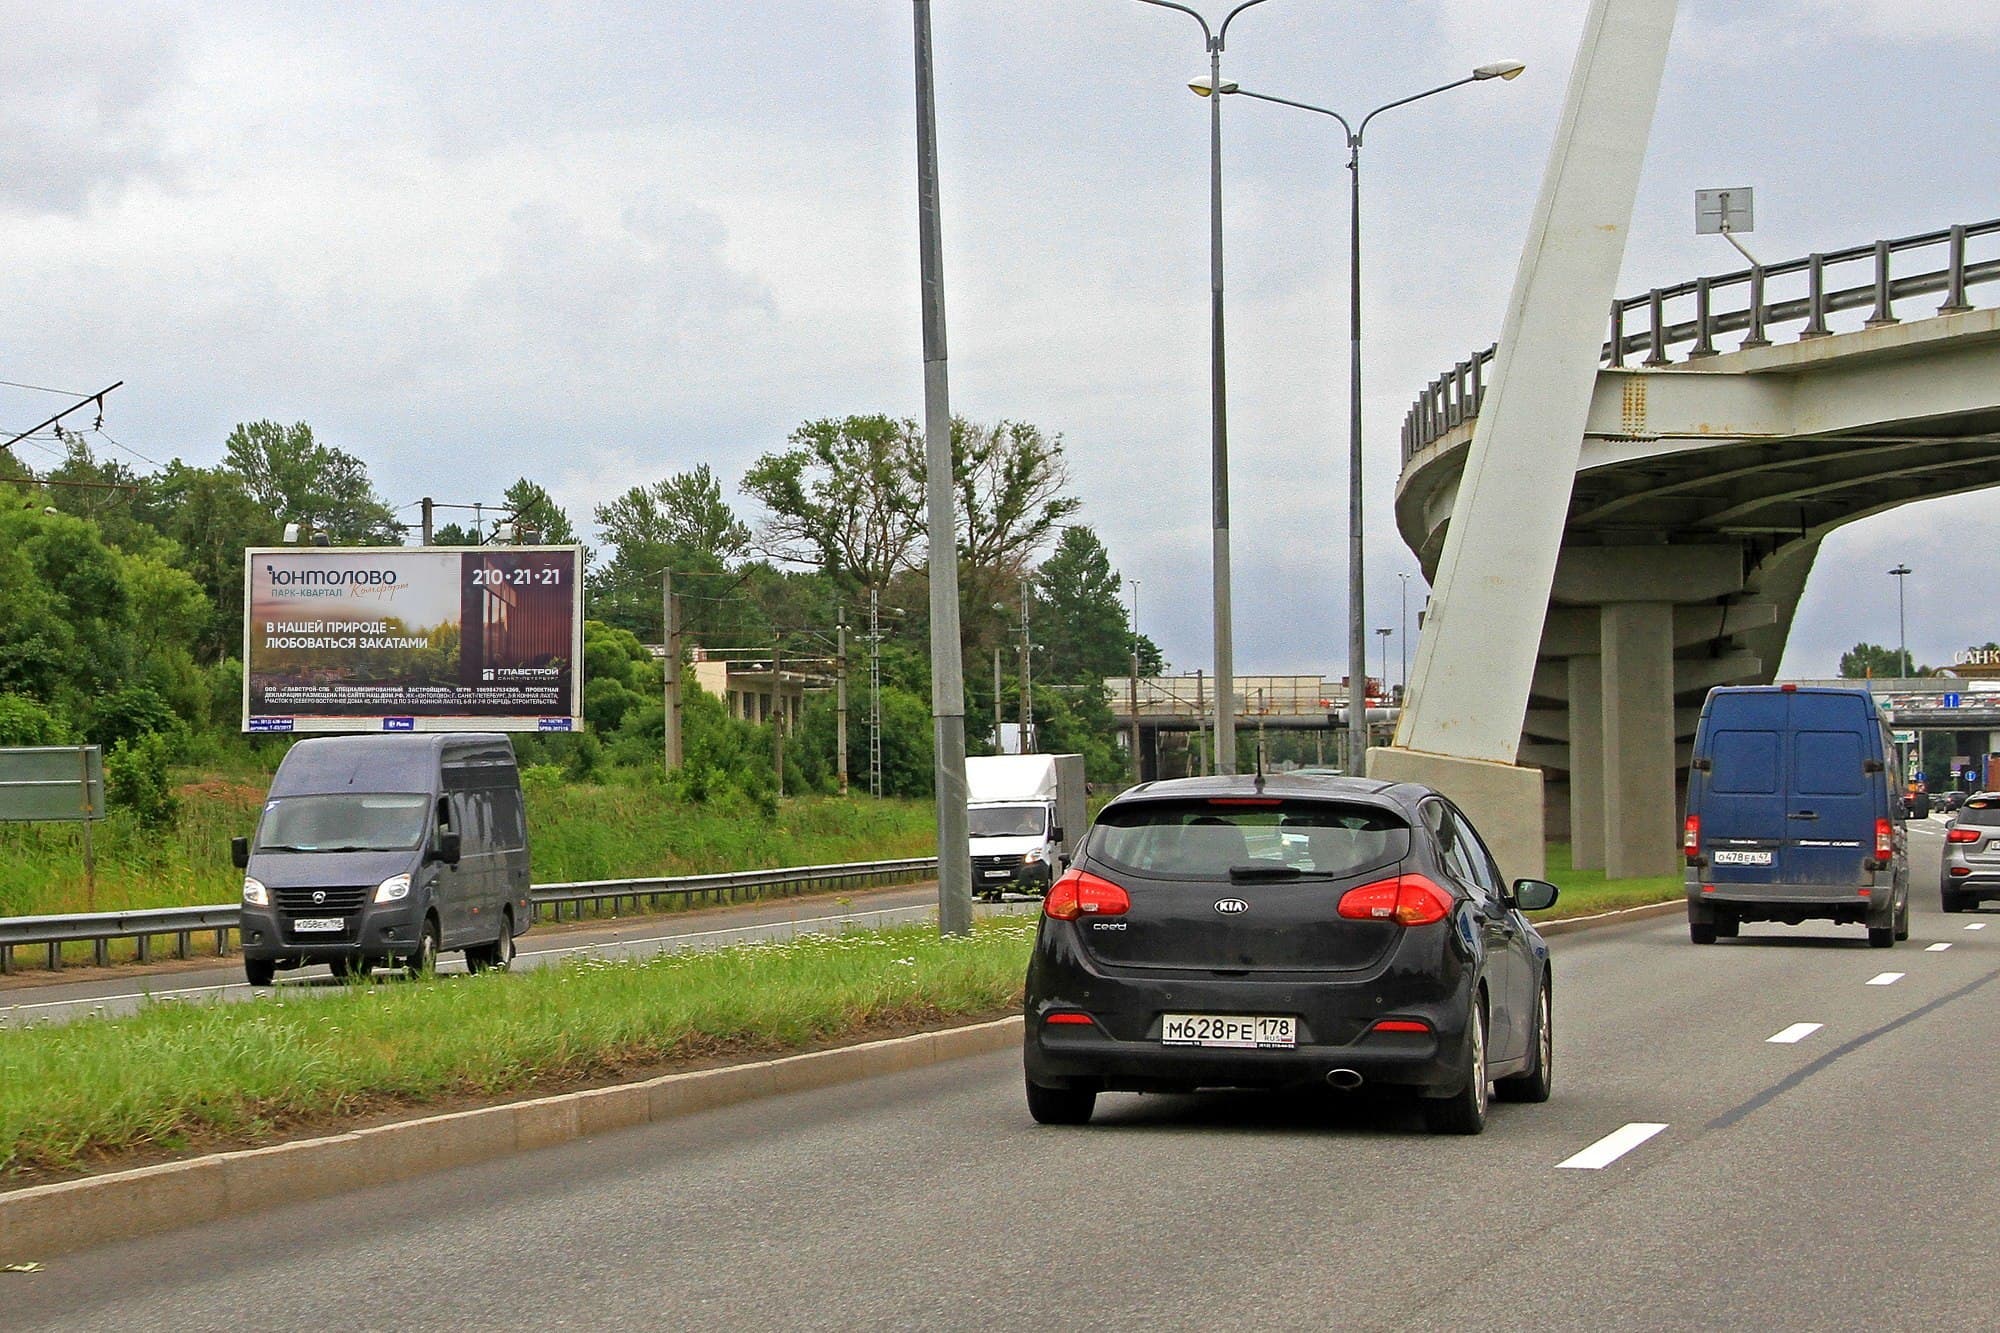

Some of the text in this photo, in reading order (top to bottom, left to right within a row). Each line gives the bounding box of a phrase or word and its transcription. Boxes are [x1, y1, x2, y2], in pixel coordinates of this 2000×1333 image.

[272, 570, 397, 585] ЮНТОЛОВО
[271, 588, 343, 597] ПАРК-КВАРТАЛ
[266, 622, 274, 633] В
[277, 619, 323, 633] НАШЕЙ
[326, 622, 387, 635] ПРИРОДЕ
[265, 637, 428, 649] ЛЮБОВАТЬСЯ ЗАКАТАМИ
[497, 667, 559, 676] ГЛАВСТРОЙ
[1219, 901, 1243, 912] KIA
[1169, 1018, 1289, 1040] М628РЕ 178
